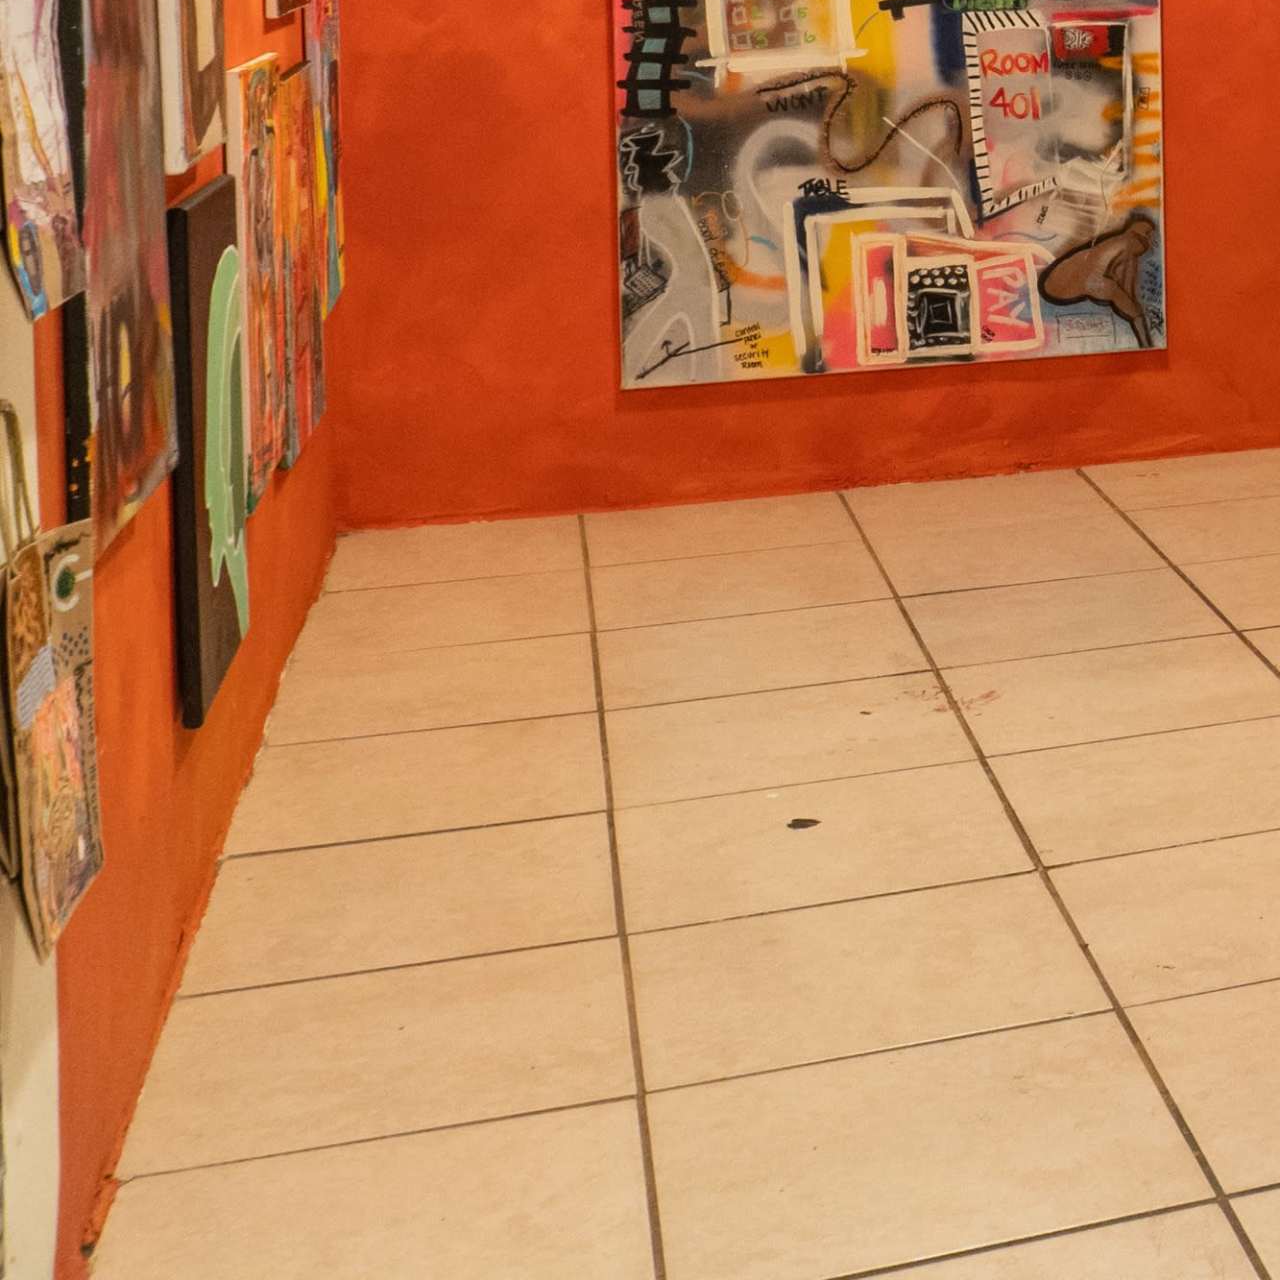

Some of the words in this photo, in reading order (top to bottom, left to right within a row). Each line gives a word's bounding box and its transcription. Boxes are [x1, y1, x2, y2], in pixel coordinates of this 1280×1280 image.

[980, 48, 1049, 78] ROOM
[989, 87, 1041, 121] 401
[798, 178, 849, 198] TABLE
[982, 267, 1031, 328] PAY
